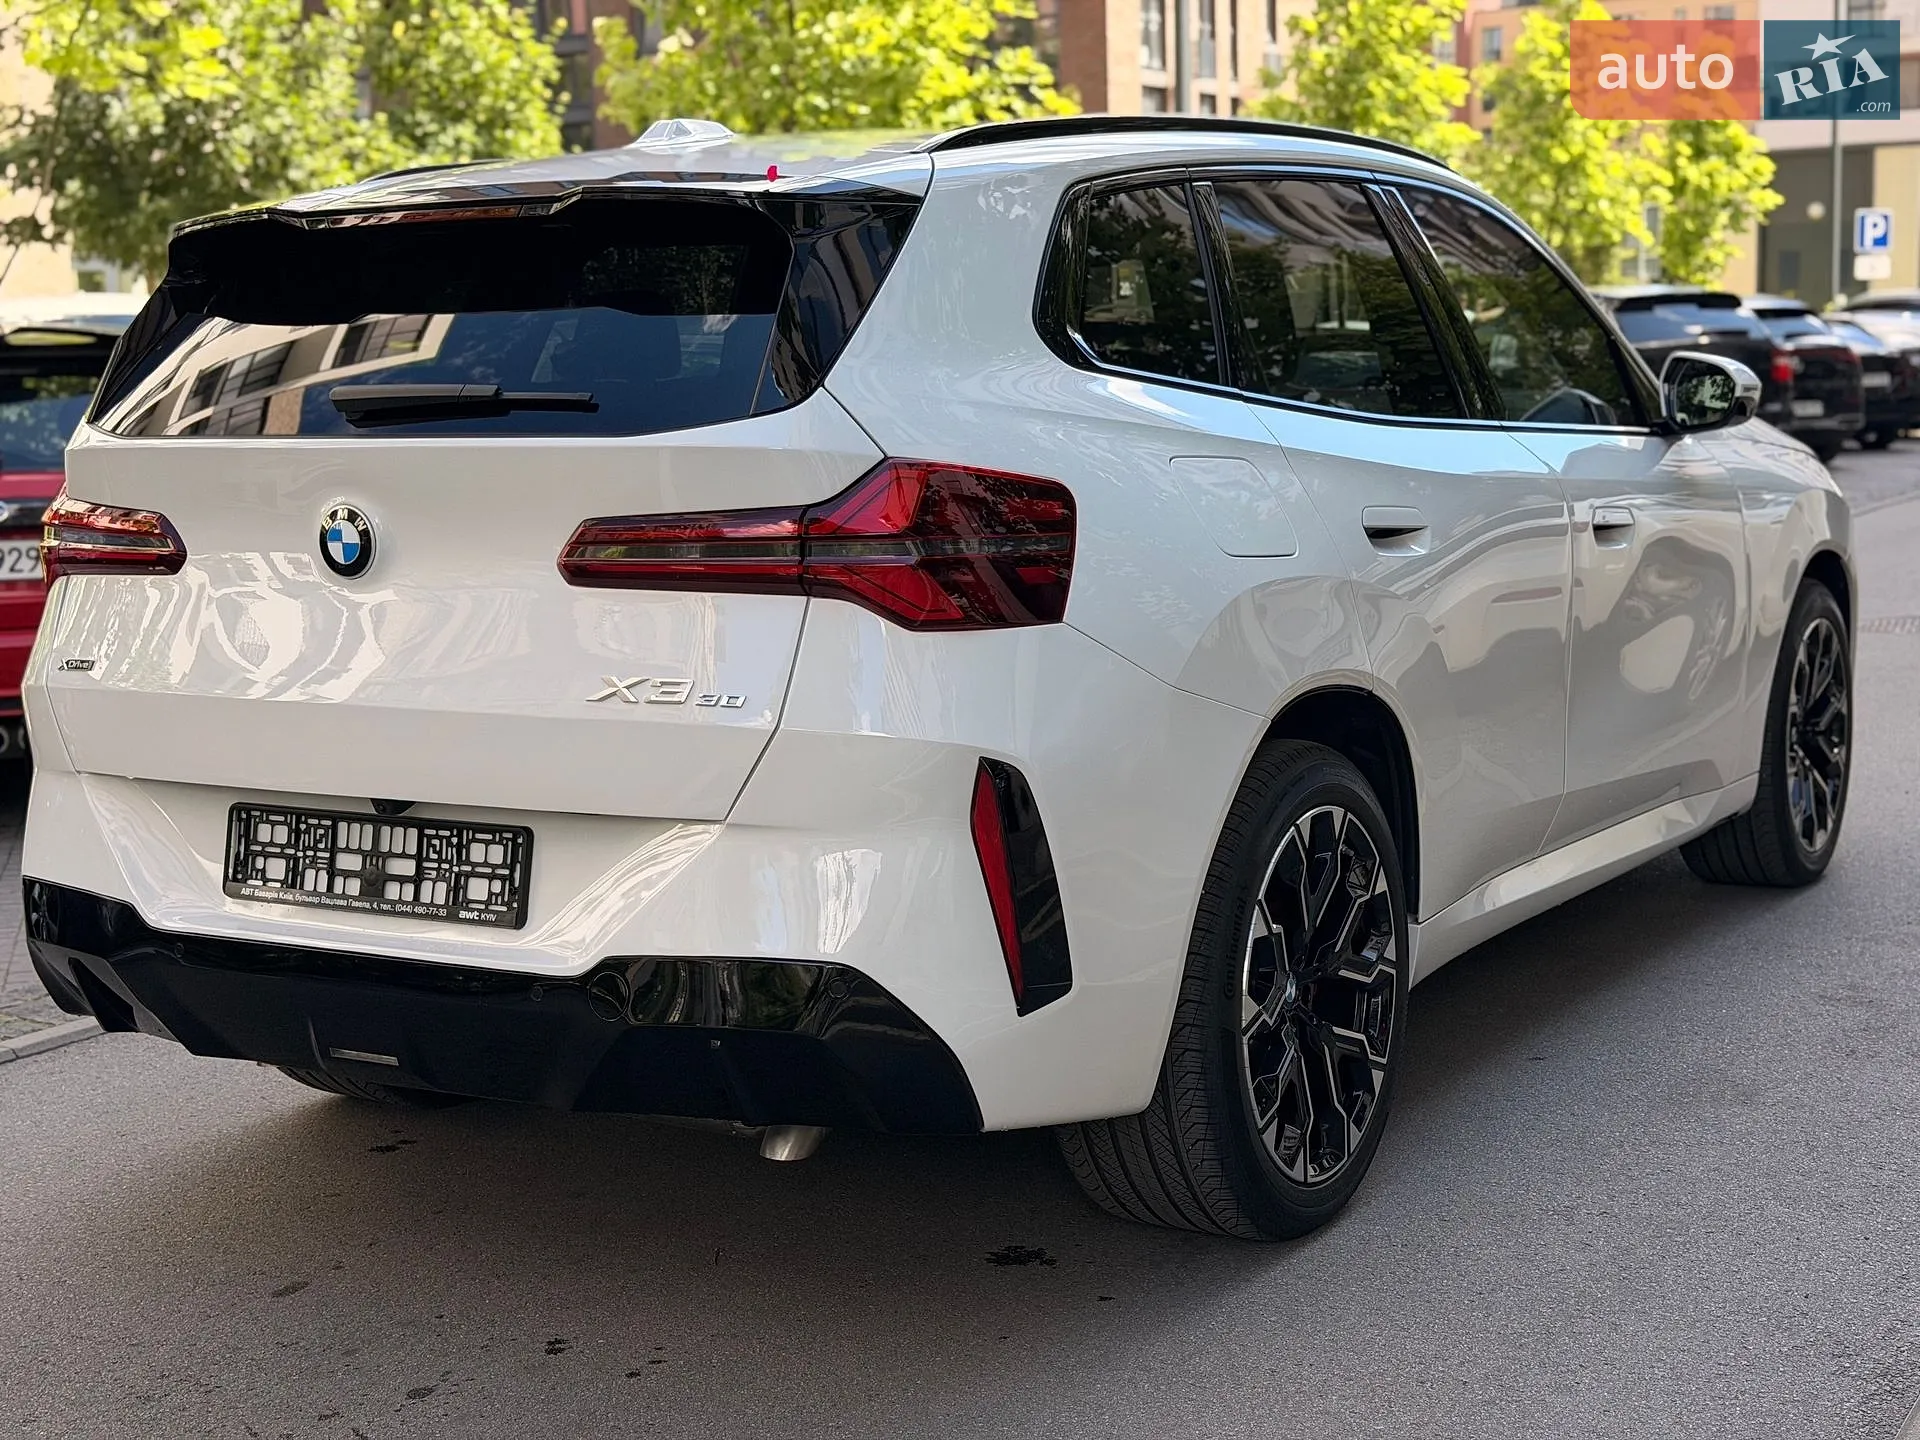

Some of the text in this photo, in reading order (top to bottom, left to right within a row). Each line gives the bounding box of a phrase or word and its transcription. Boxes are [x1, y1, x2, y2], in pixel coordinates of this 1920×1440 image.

[1863, 213, 1887, 249] P
[321, 507, 368, 532] BMW
[585, 675, 747, 708] X3 30
[395, 904, 413, 914] (044)
[413, 906, 447, 917] 490-77-33
[459, 910, 497, 922] awt KYIV
